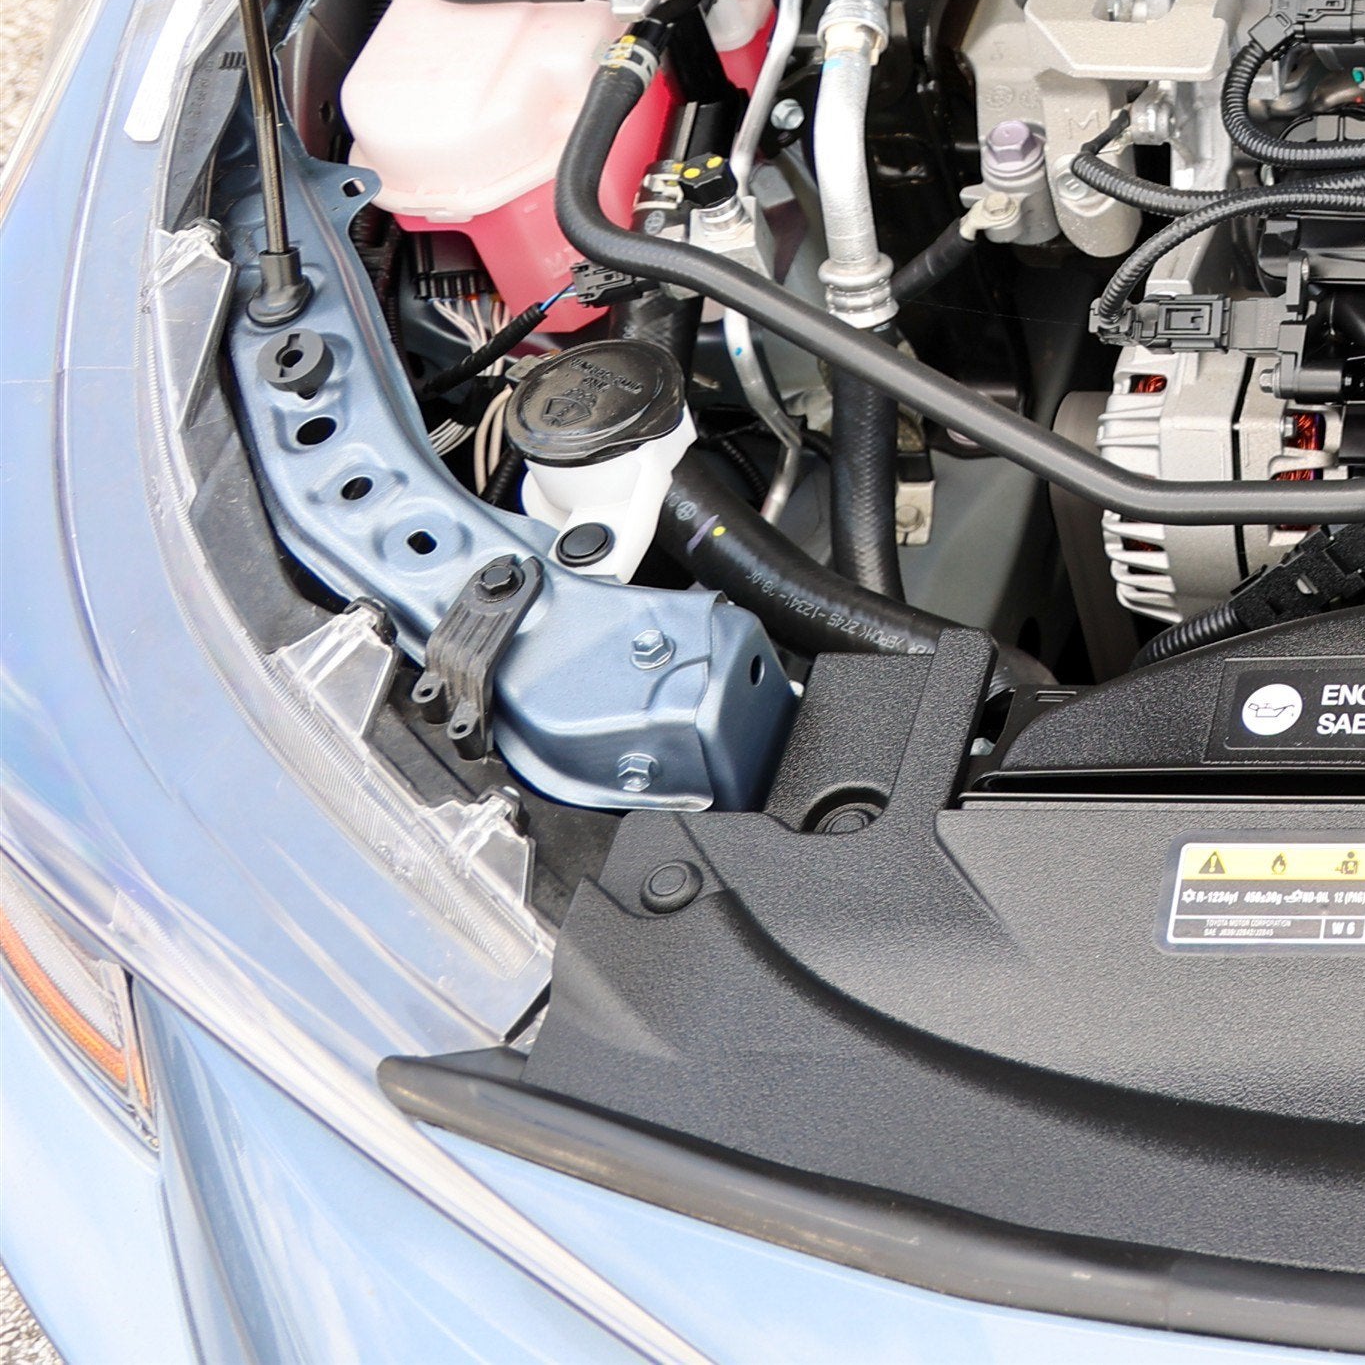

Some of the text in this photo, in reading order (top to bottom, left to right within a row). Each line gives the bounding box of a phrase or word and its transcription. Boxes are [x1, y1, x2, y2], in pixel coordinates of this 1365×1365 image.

[1204, 919, 1292, 928] TOYOTA MOTOR CORPORATION
[1331, 921, 1345, 936] W
